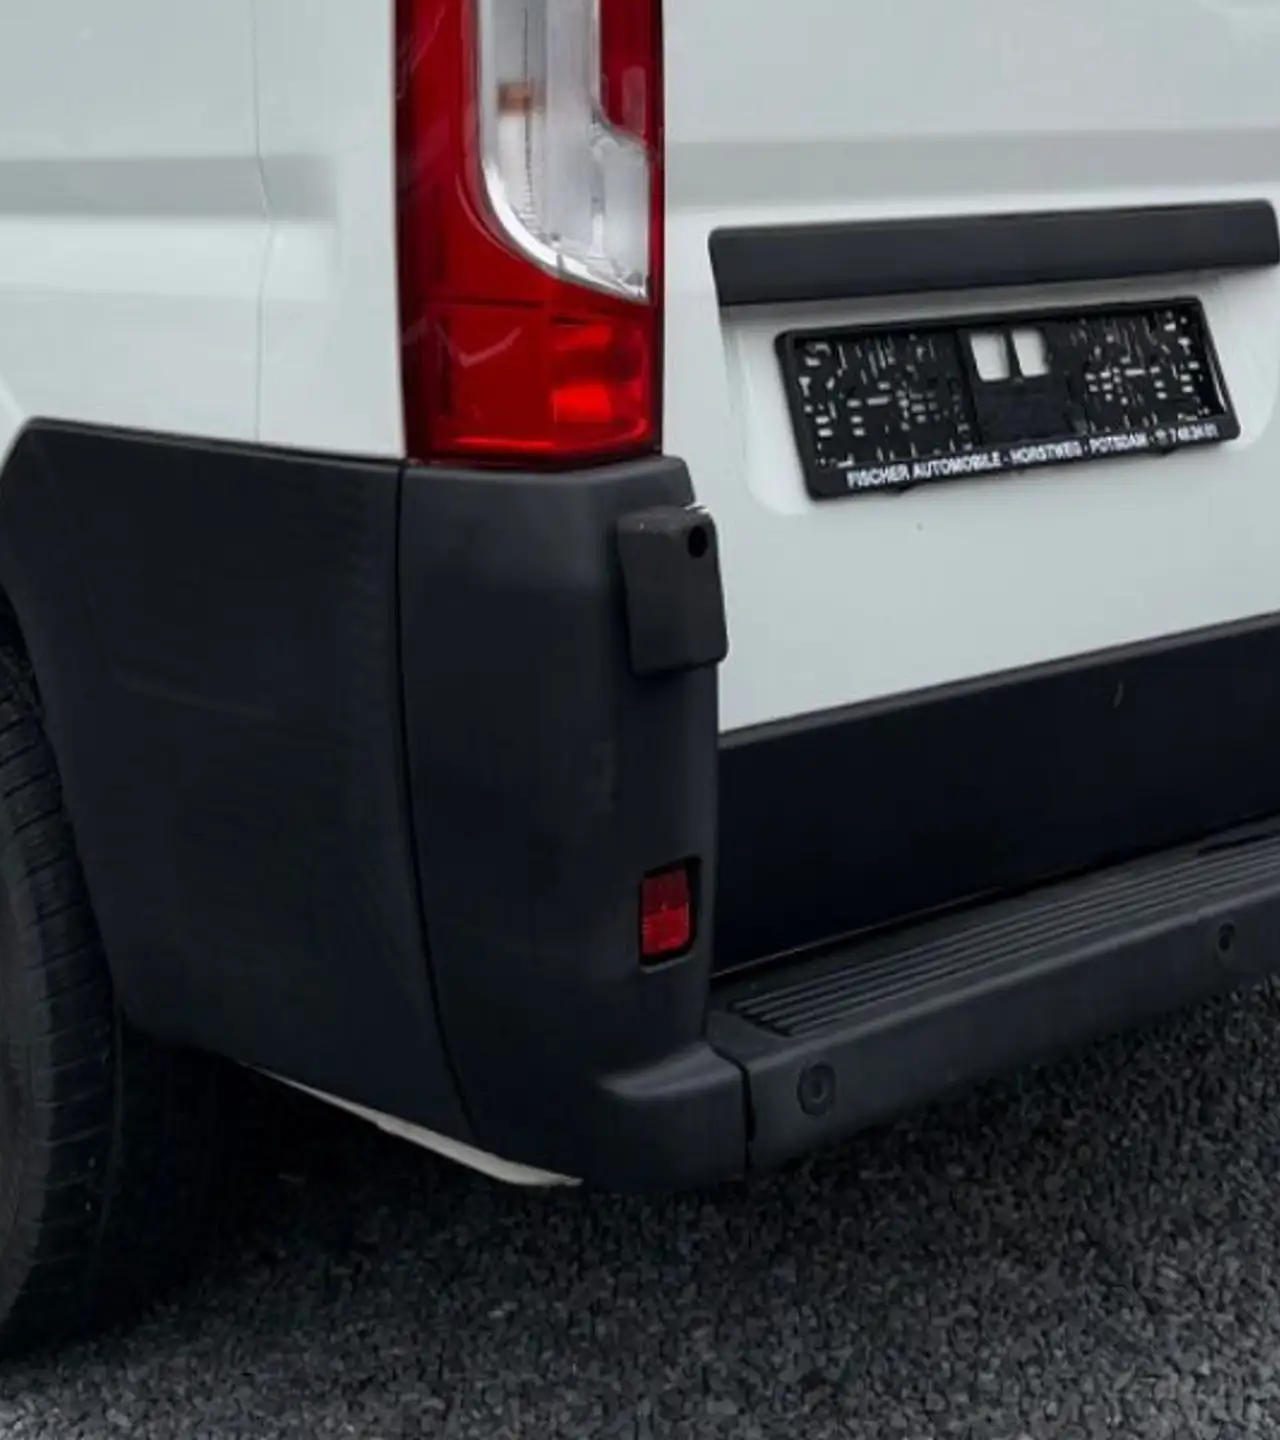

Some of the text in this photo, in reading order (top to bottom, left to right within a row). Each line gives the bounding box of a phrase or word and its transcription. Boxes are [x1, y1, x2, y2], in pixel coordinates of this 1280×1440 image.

[846, 463, 911, 489] FISCHER
[913, 450, 1003, 479] AUTOMOBILE
[1089, 432, 1150, 453] POTSDAM
